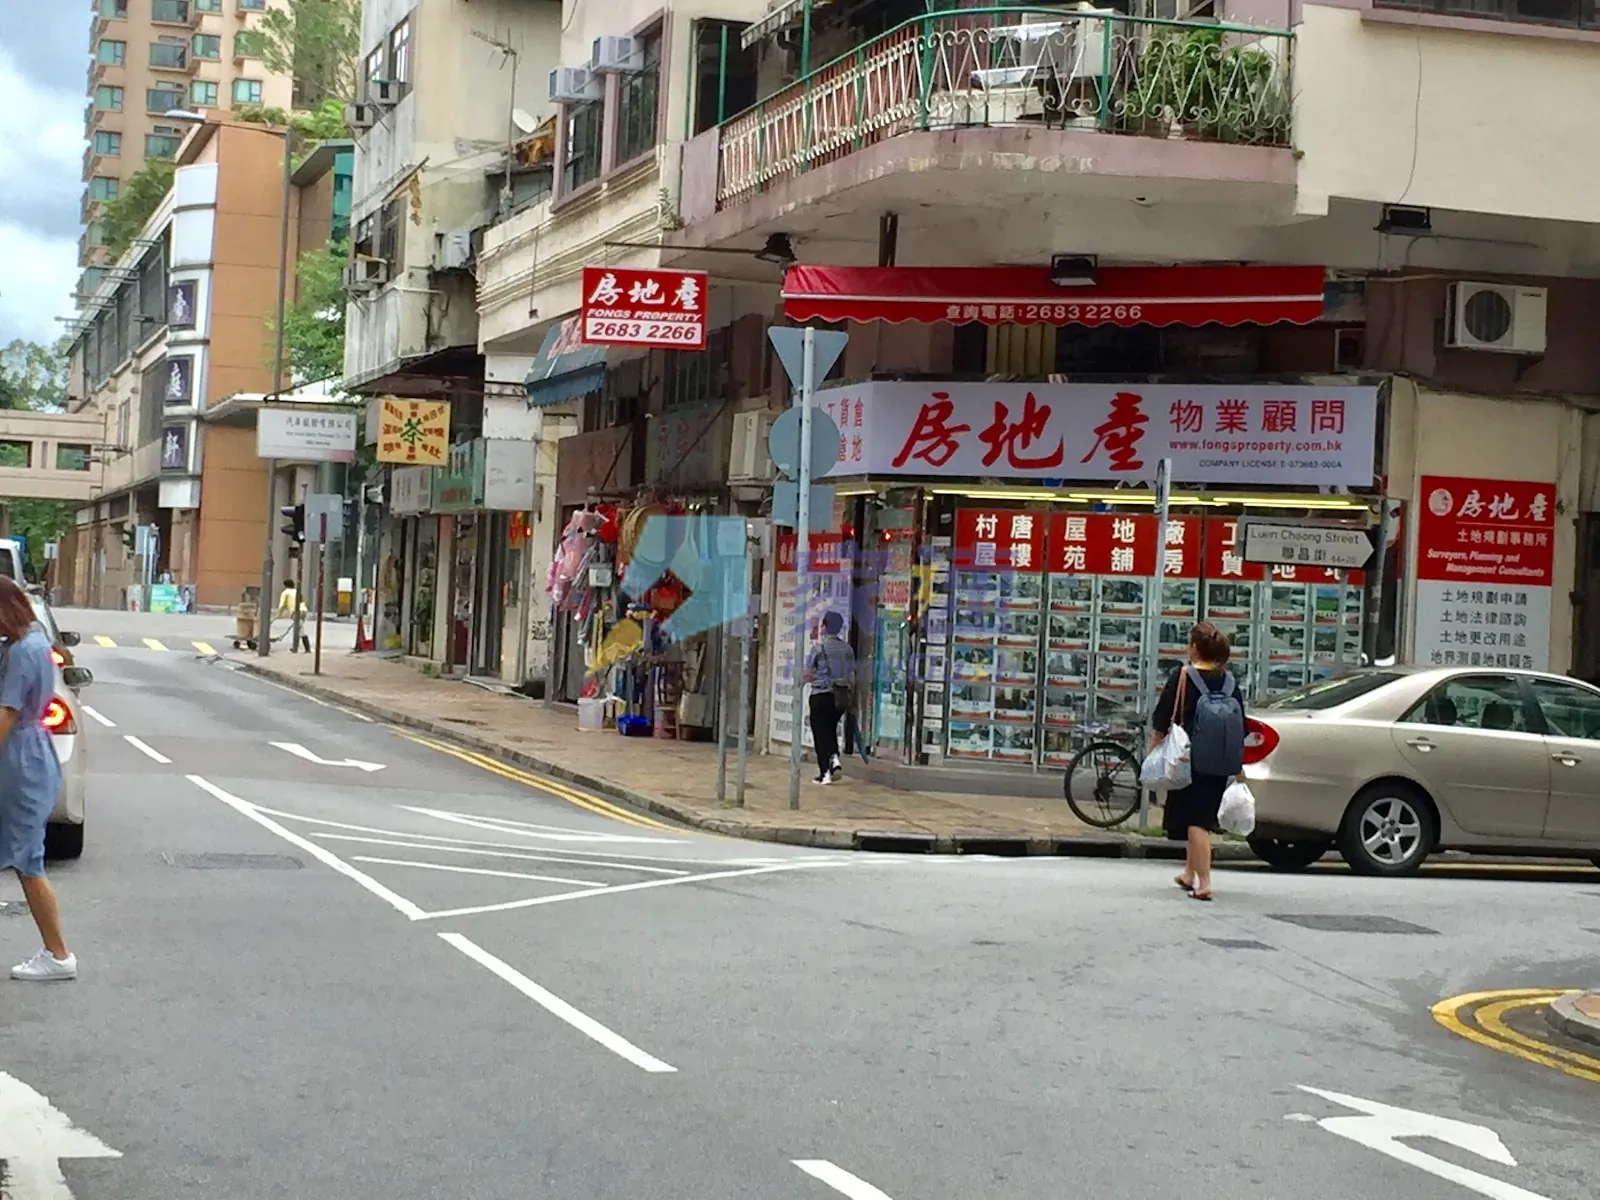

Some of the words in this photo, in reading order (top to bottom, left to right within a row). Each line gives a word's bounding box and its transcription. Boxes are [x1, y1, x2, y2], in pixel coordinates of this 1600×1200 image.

[588, 273, 700, 310] 房地產
[586, 309, 631, 319] FONGS
[633, 311, 702, 322] PROPERTY
[1026, 305, 1080, 319] 2683
[1085, 305, 1142, 319] 2266
[591, 322, 641, 337] 2683
[646, 325, 696, 340] 2266
[1168, 399, 1346, 434] 物業顧問
[400, 418, 427, 445] 茶
[891, 392, 1149, 471] 房地產
[1169, 438, 1342, 453] www.fongsproperty.com.hk
[1199, 459, 1239, 468] COMPANY
[1456, 489, 1548, 522] 房地產
[974, 514, 998, 567] 村屋
[1009, 514, 1033, 568] 唐樓
[1063, 517, 1087, 570] 屋苑
[1251, 528, 1278, 540] Luen
[1325, 531, 1359, 544] Street
[1469, 551, 1503, 564] Planning
[1504, 554, 1520, 562] and
[1446, 563, 1497, 575] Management
[1498, 565, 1544, 577] Consultants
[1439, 630, 1526, 648] 土地更改用途
